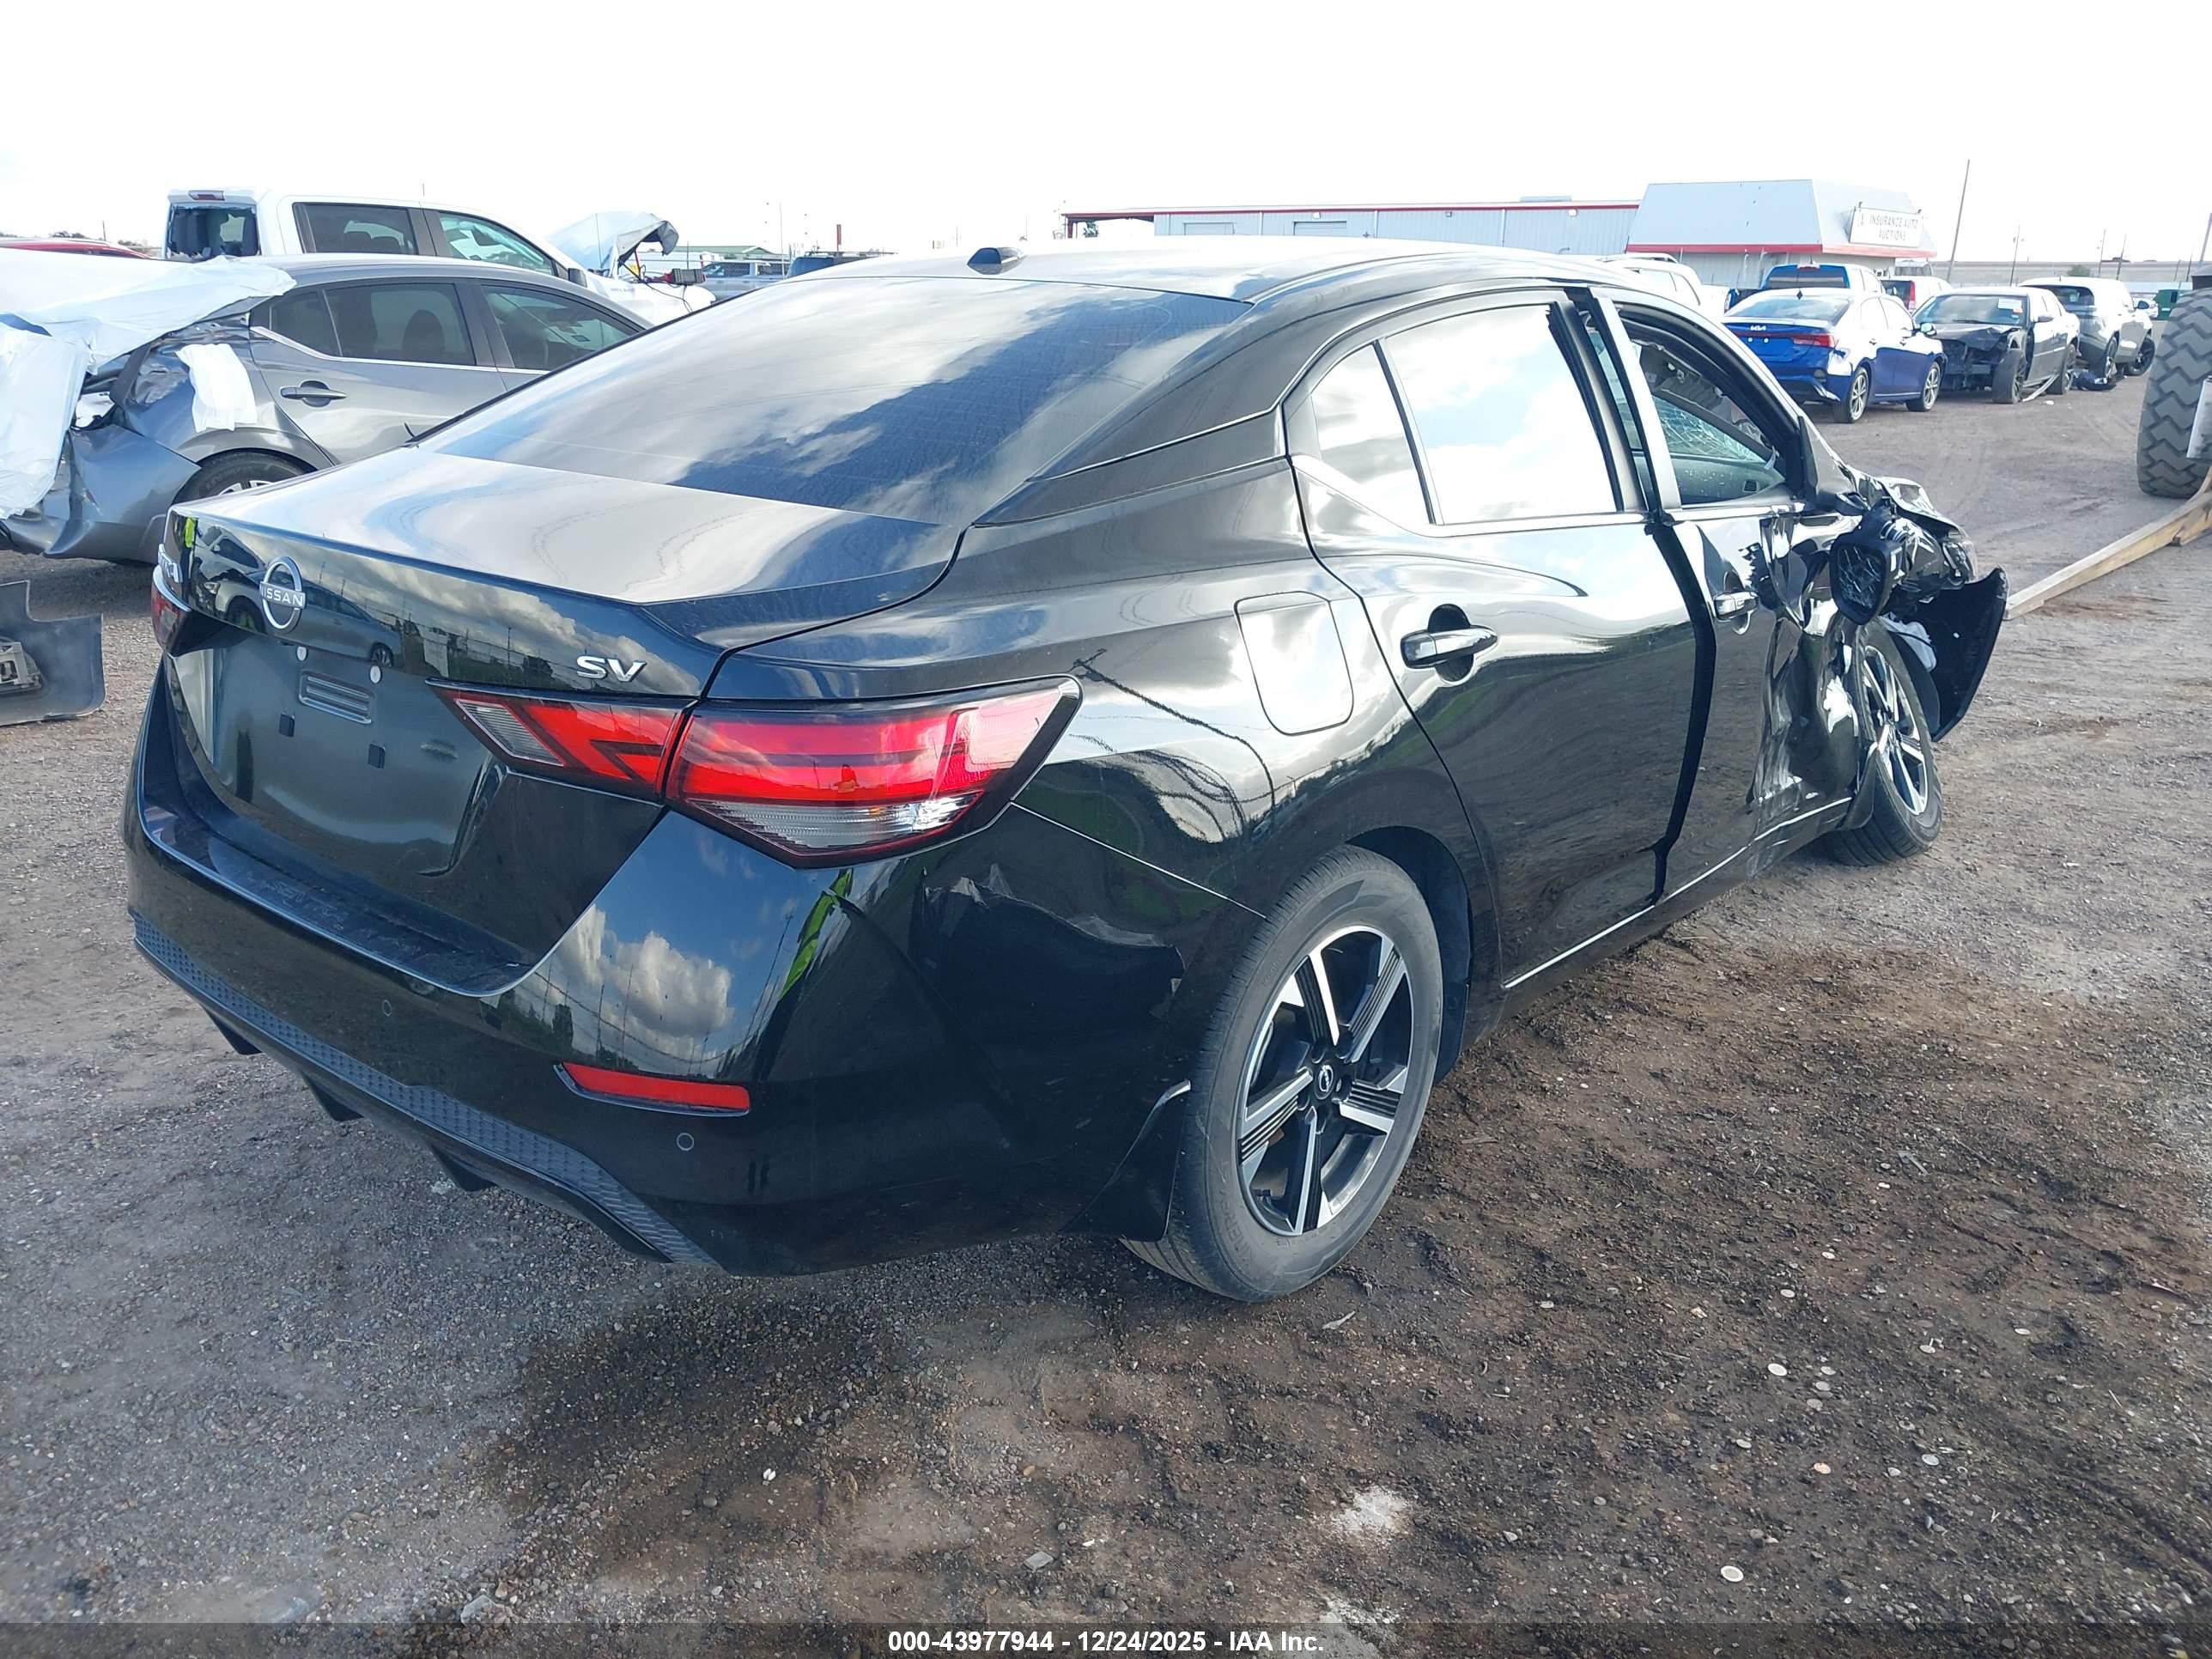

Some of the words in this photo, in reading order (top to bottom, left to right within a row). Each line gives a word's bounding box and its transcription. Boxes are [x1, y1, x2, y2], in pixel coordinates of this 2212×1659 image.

[1869, 213, 1903, 228] INSURANCE
[1904, 218, 1919, 229] AUTO
[1878, 228, 1906, 241] AUCTIONS
[576, 655, 648, 683] SV
